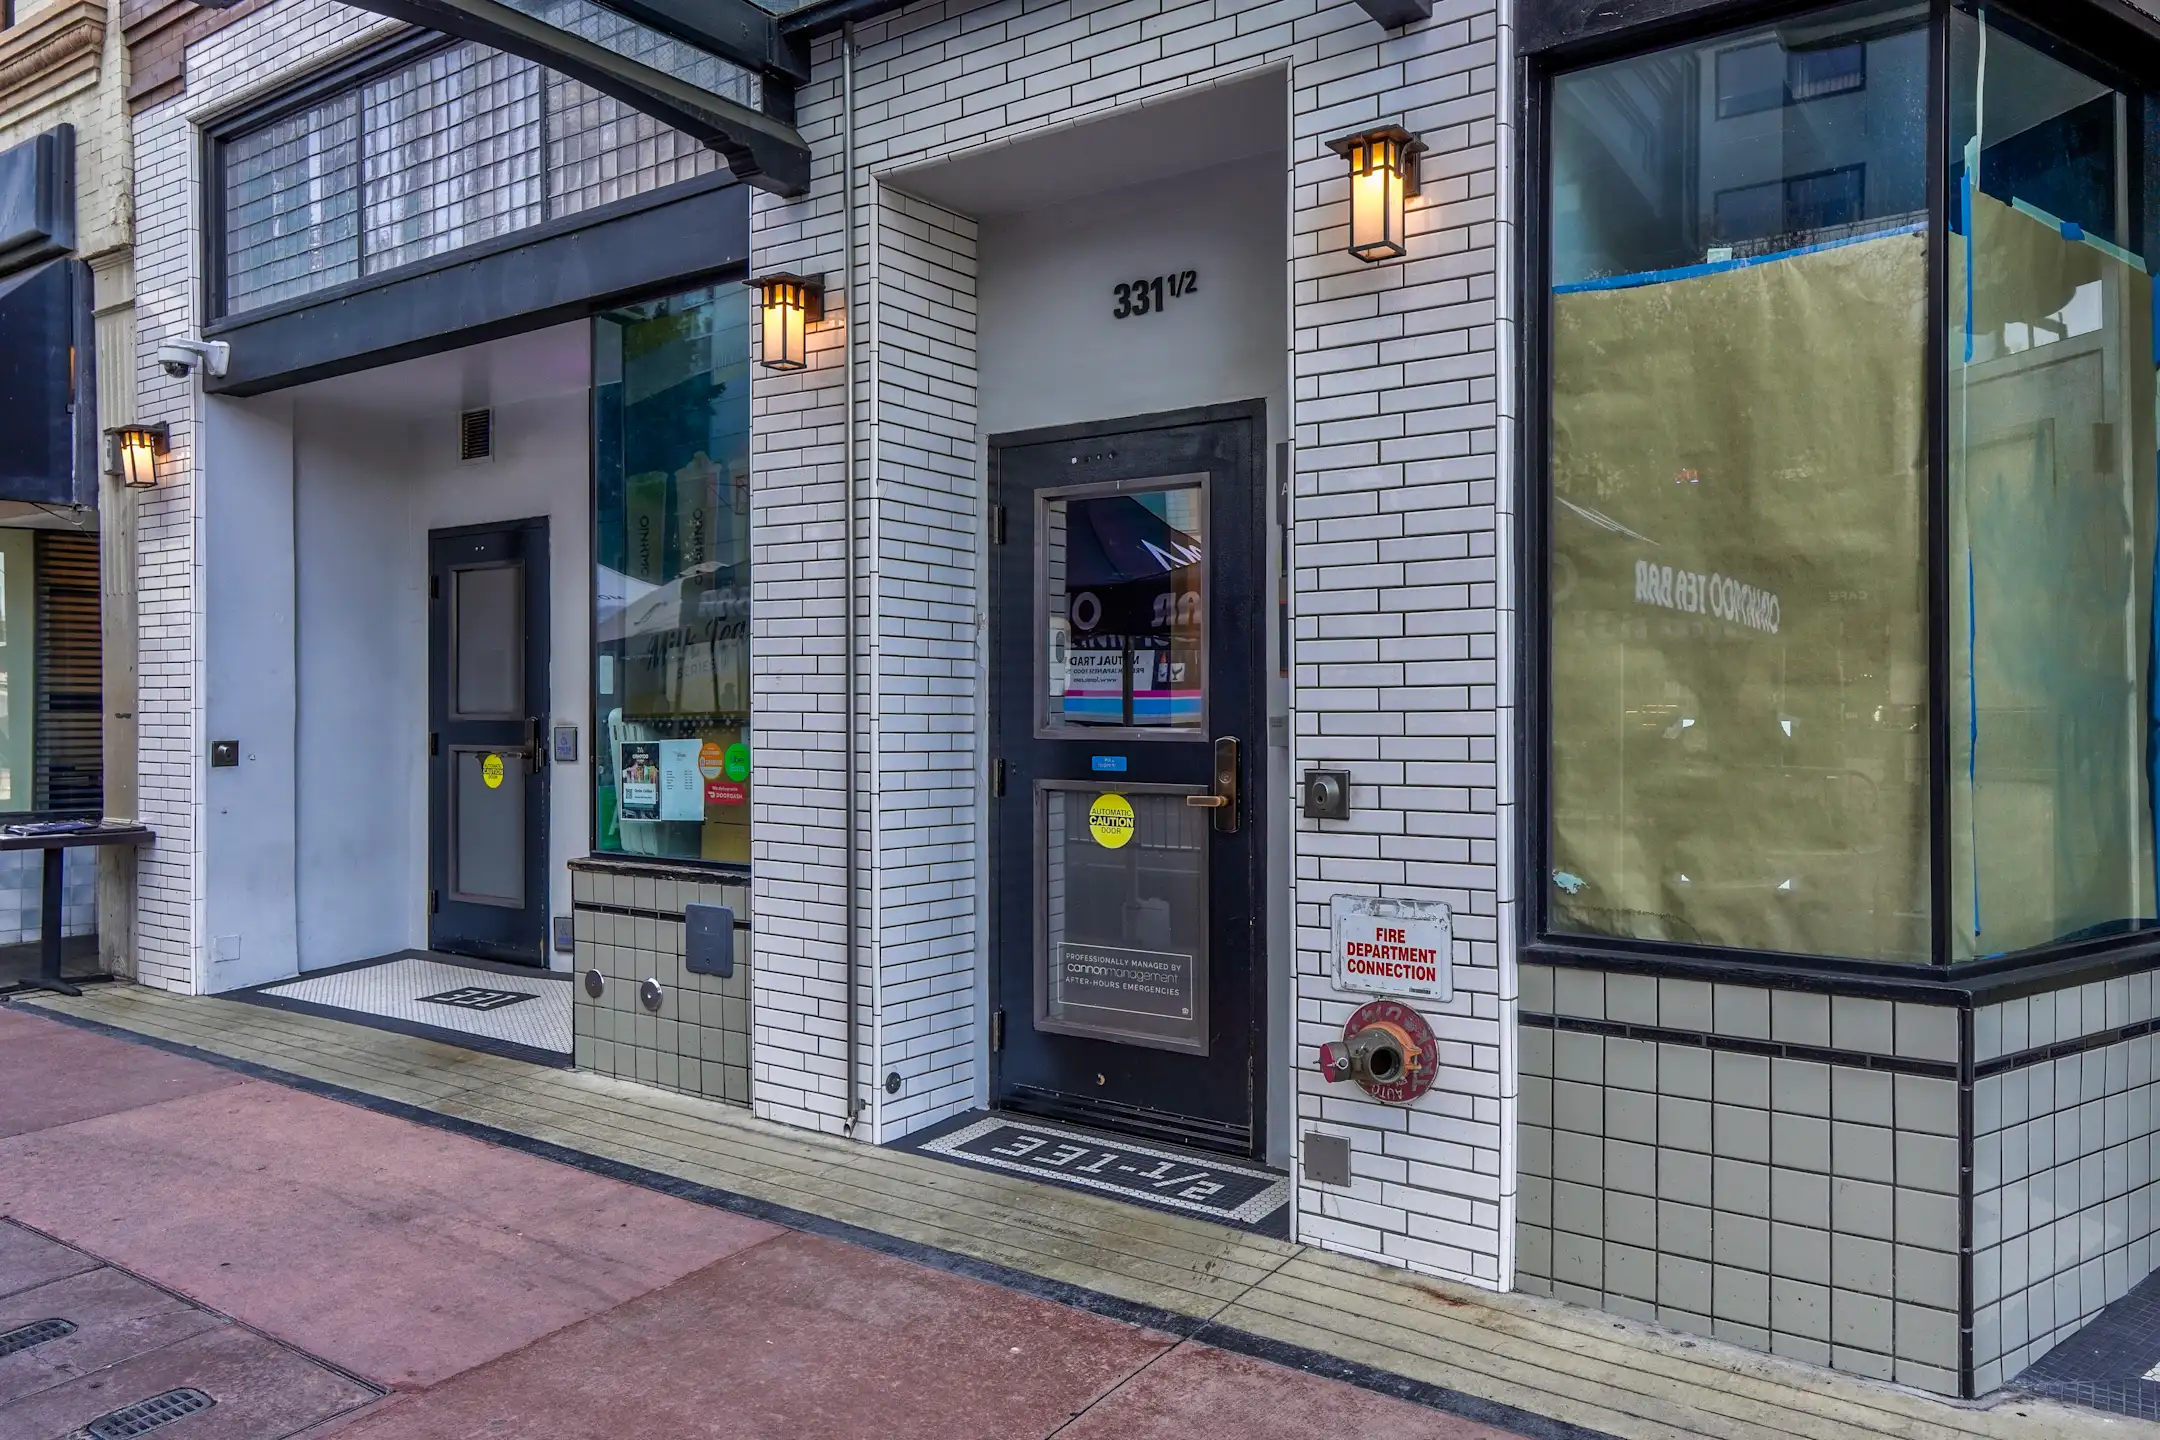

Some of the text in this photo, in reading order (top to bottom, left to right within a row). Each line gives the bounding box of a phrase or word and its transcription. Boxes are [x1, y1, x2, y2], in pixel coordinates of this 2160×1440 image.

[1113, 269, 1198, 319] 331 1/2
[1089, 816, 1134, 827] CAUTION
[1092, 808, 1132, 817] AUTOMATIC
[1376, 927, 1405, 944] FIRE
[1066, 952, 1181, 972] PROFESSIONALLY MANAGED BY
[1347, 942, 1436, 964] DEPARTMENT
[1347, 959, 1436, 982] CONNECTION
[1065, 976, 1180, 996] AFTER-HOURS EMERGENCIES
